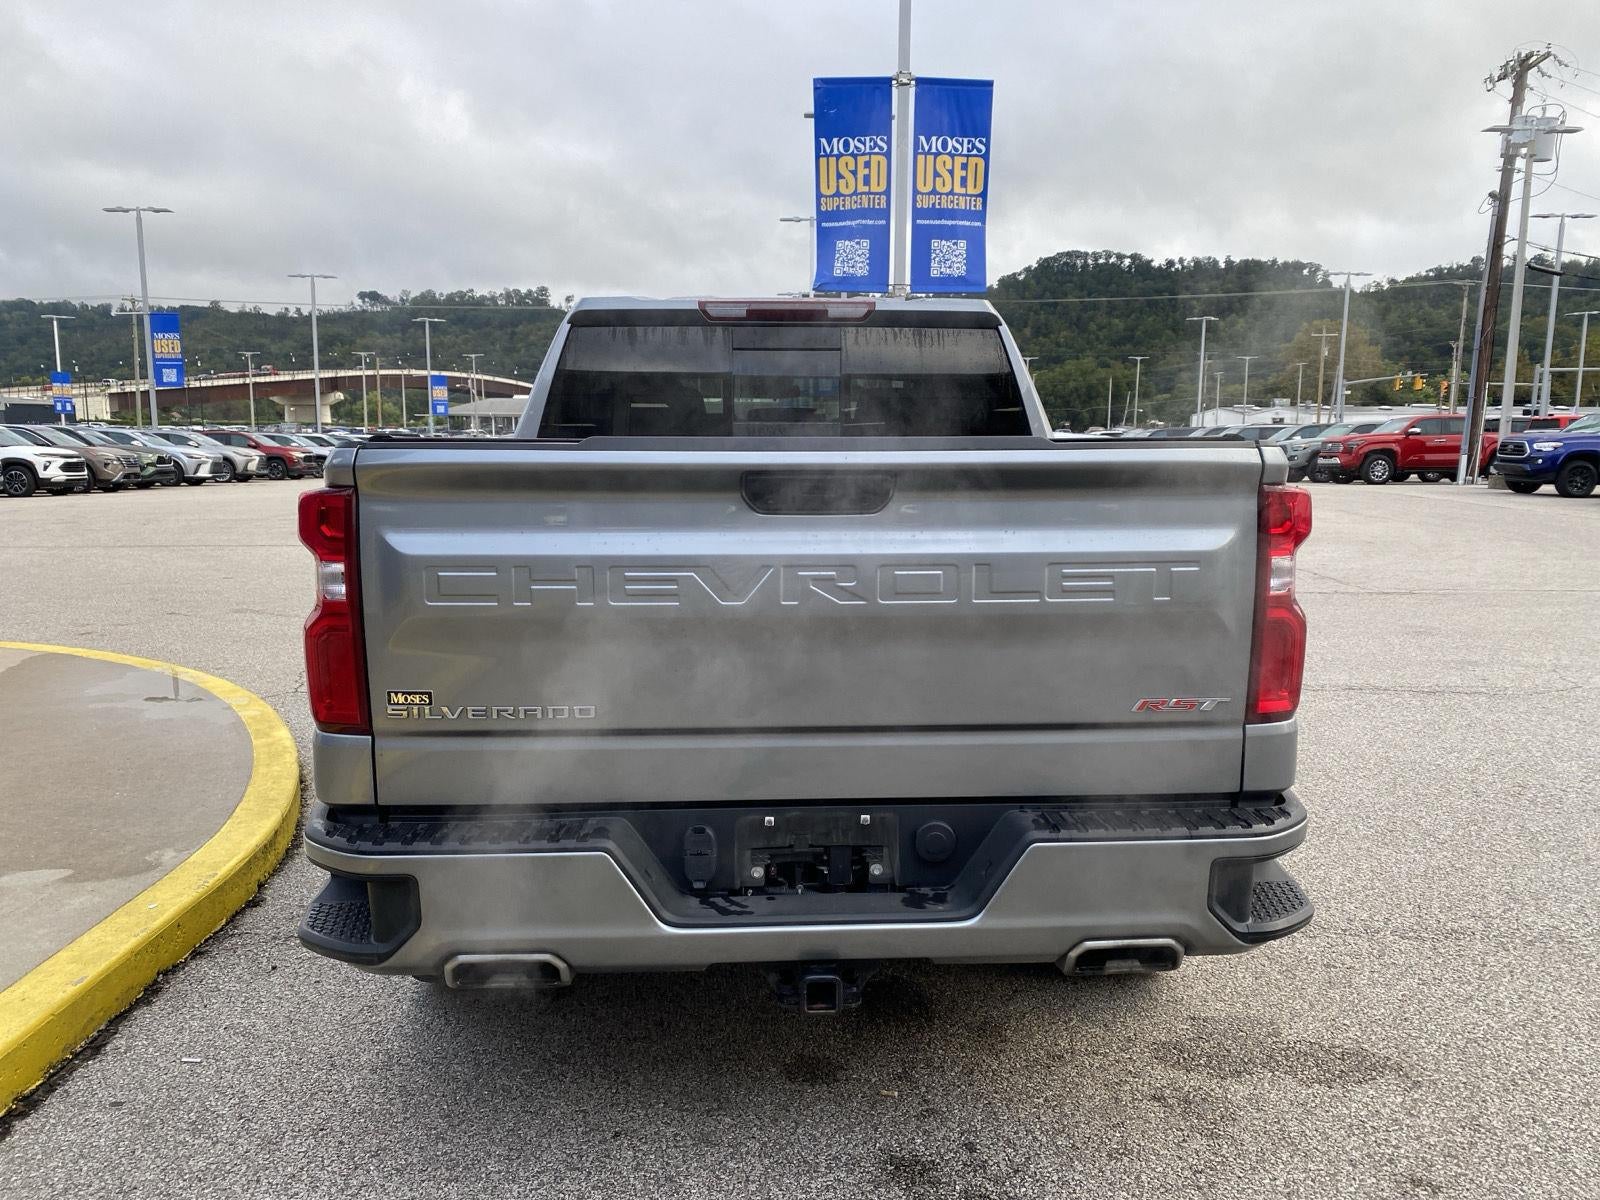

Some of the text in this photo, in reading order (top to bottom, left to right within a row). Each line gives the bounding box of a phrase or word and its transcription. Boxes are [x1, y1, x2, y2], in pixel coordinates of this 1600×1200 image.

[819, 135, 888, 155] MOSES
[918, 135, 986, 155] MOSES
[819, 154, 888, 195] USED
[916, 154, 985, 195] USED
[820, 194, 887, 211] SUPERCENTER
[916, 194, 983, 211] SUPERCENTER
[154, 332, 180, 340] MOSES
[154, 340, 181, 353] USED
[423, 560, 1200, 606] CHEVROLET
[389, 692, 430, 705] MOSES
[1131, 697, 1232, 713] RST
[386, 705, 596, 719] SILVERADO
